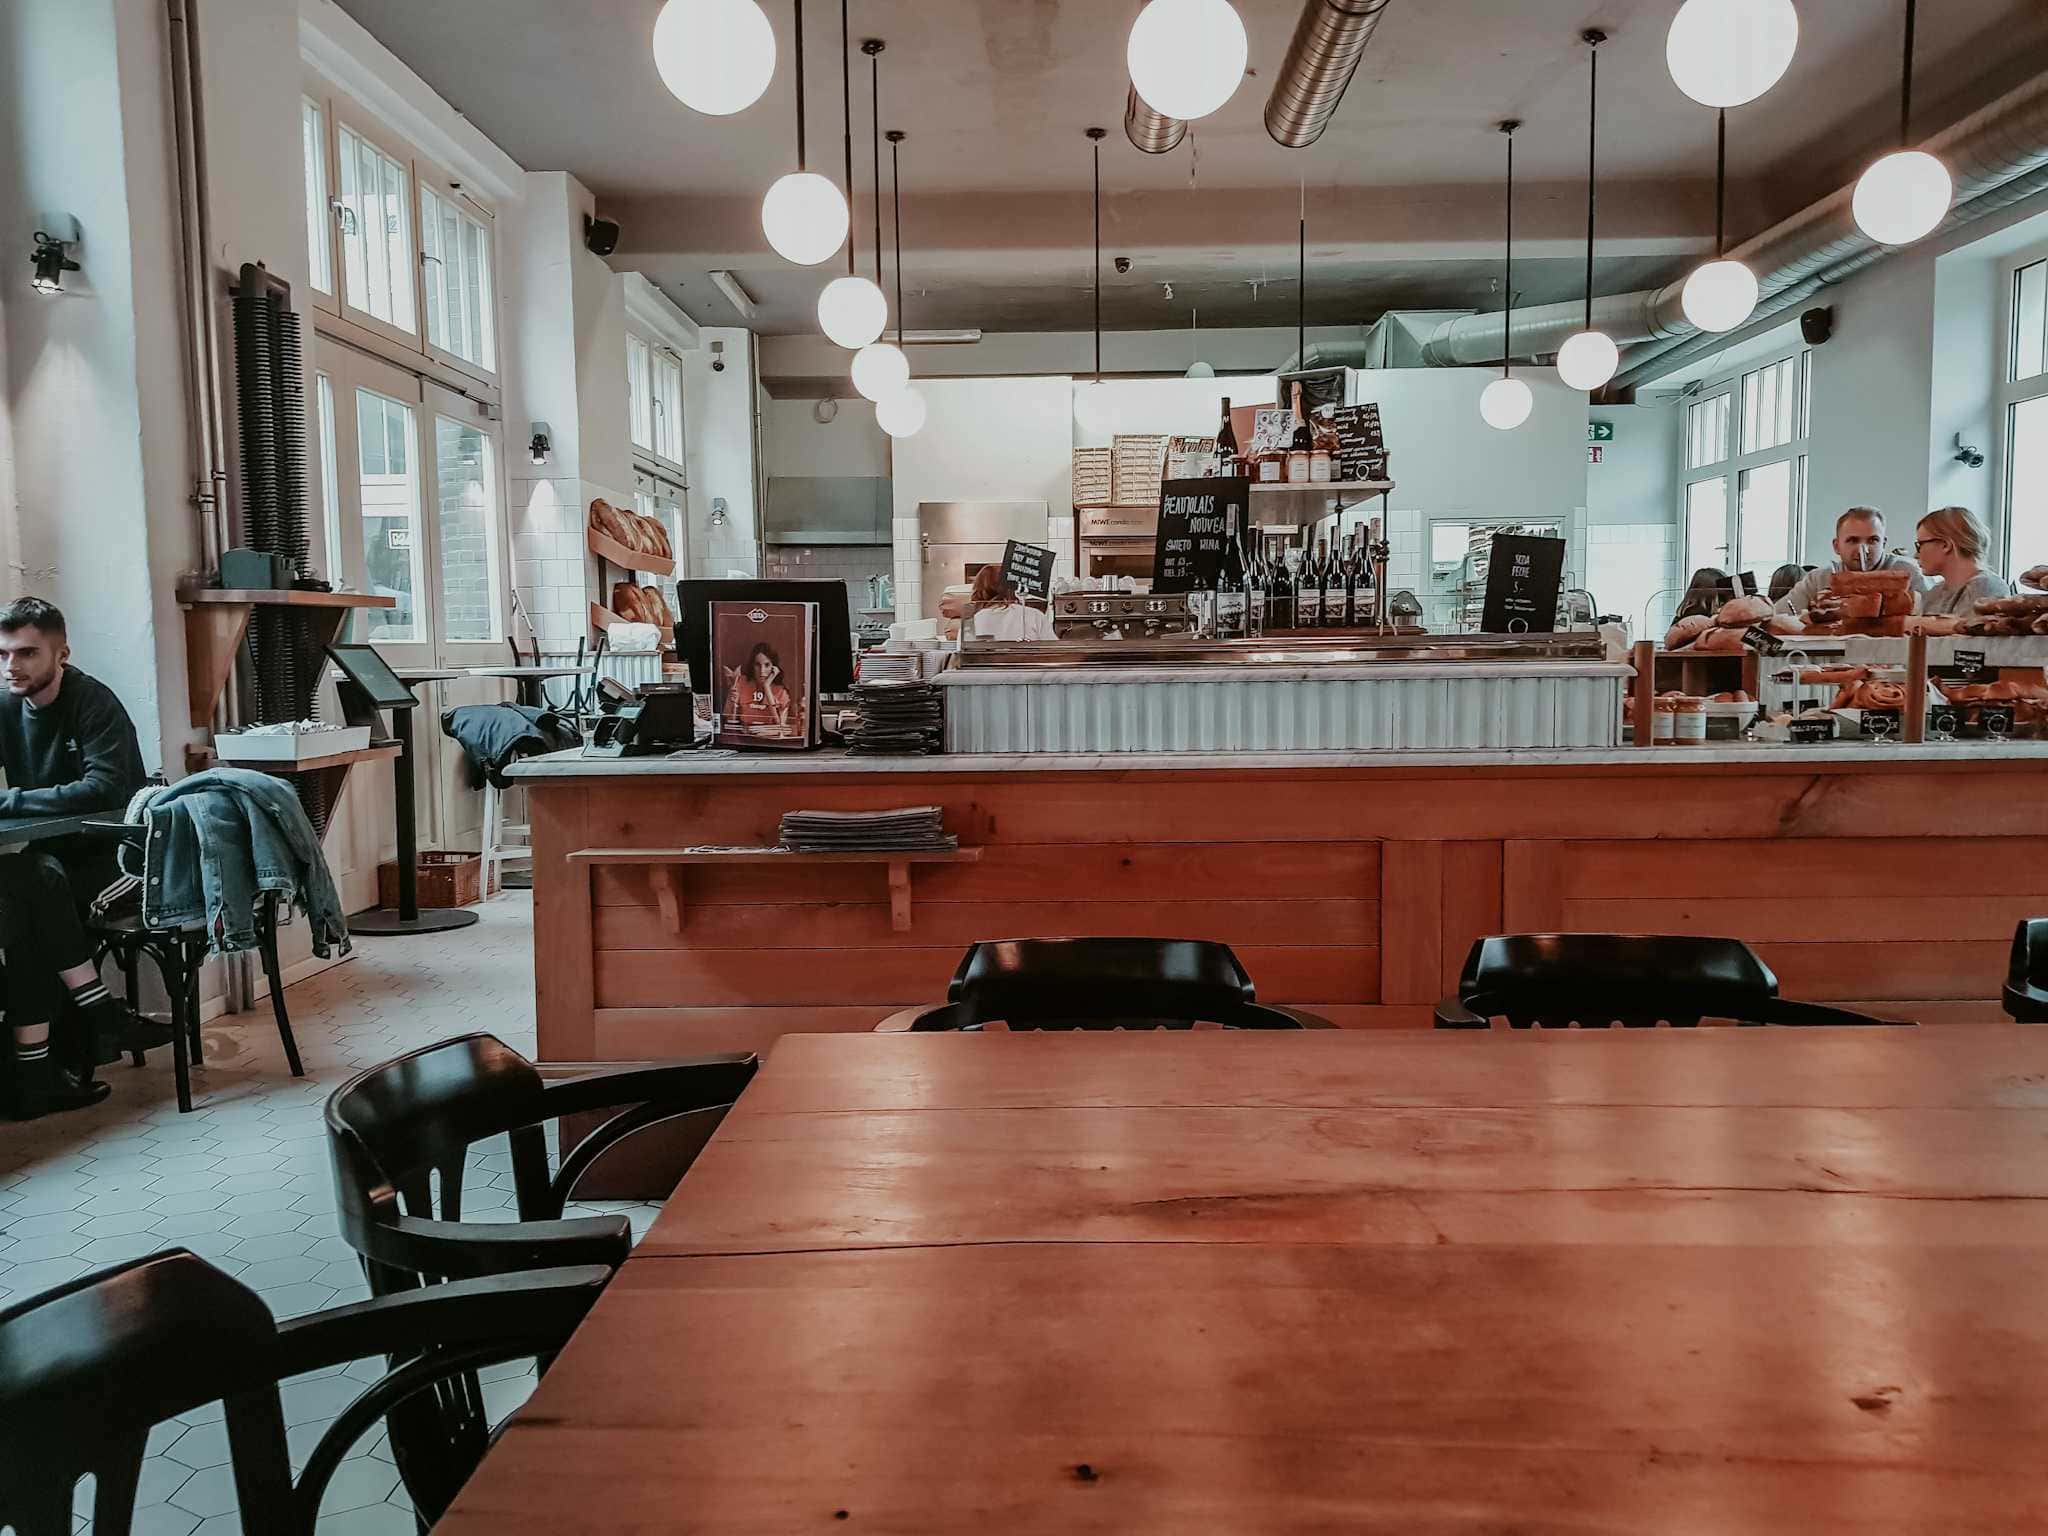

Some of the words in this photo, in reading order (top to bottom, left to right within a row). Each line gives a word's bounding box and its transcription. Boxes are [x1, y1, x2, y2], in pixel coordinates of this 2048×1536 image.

[1163, 494, 1216, 520] BEAUJOLAIS
[1188, 516, 1226, 534] NOUVEA
[752, 690, 764, 702] 19
